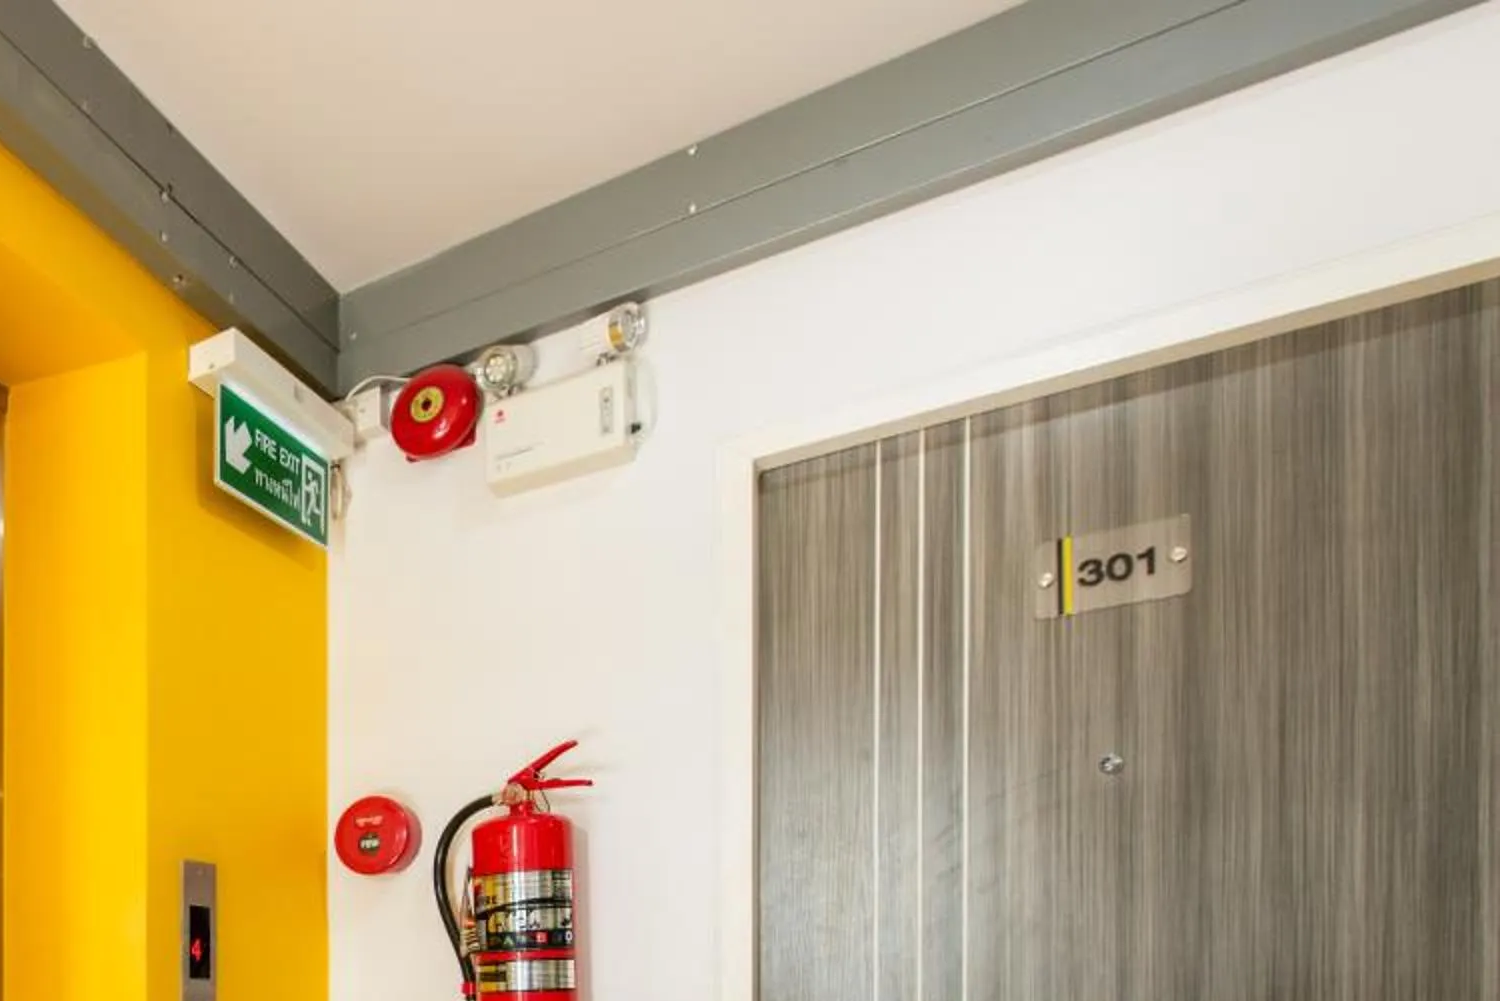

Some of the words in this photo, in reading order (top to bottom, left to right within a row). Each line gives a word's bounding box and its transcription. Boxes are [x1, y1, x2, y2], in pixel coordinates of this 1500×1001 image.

[255, 429, 277, 461] FIRE
[280, 447, 300, 475] EXIT
[1077, 546, 1156, 587] 301
[190, 937, 202, 962] 4
